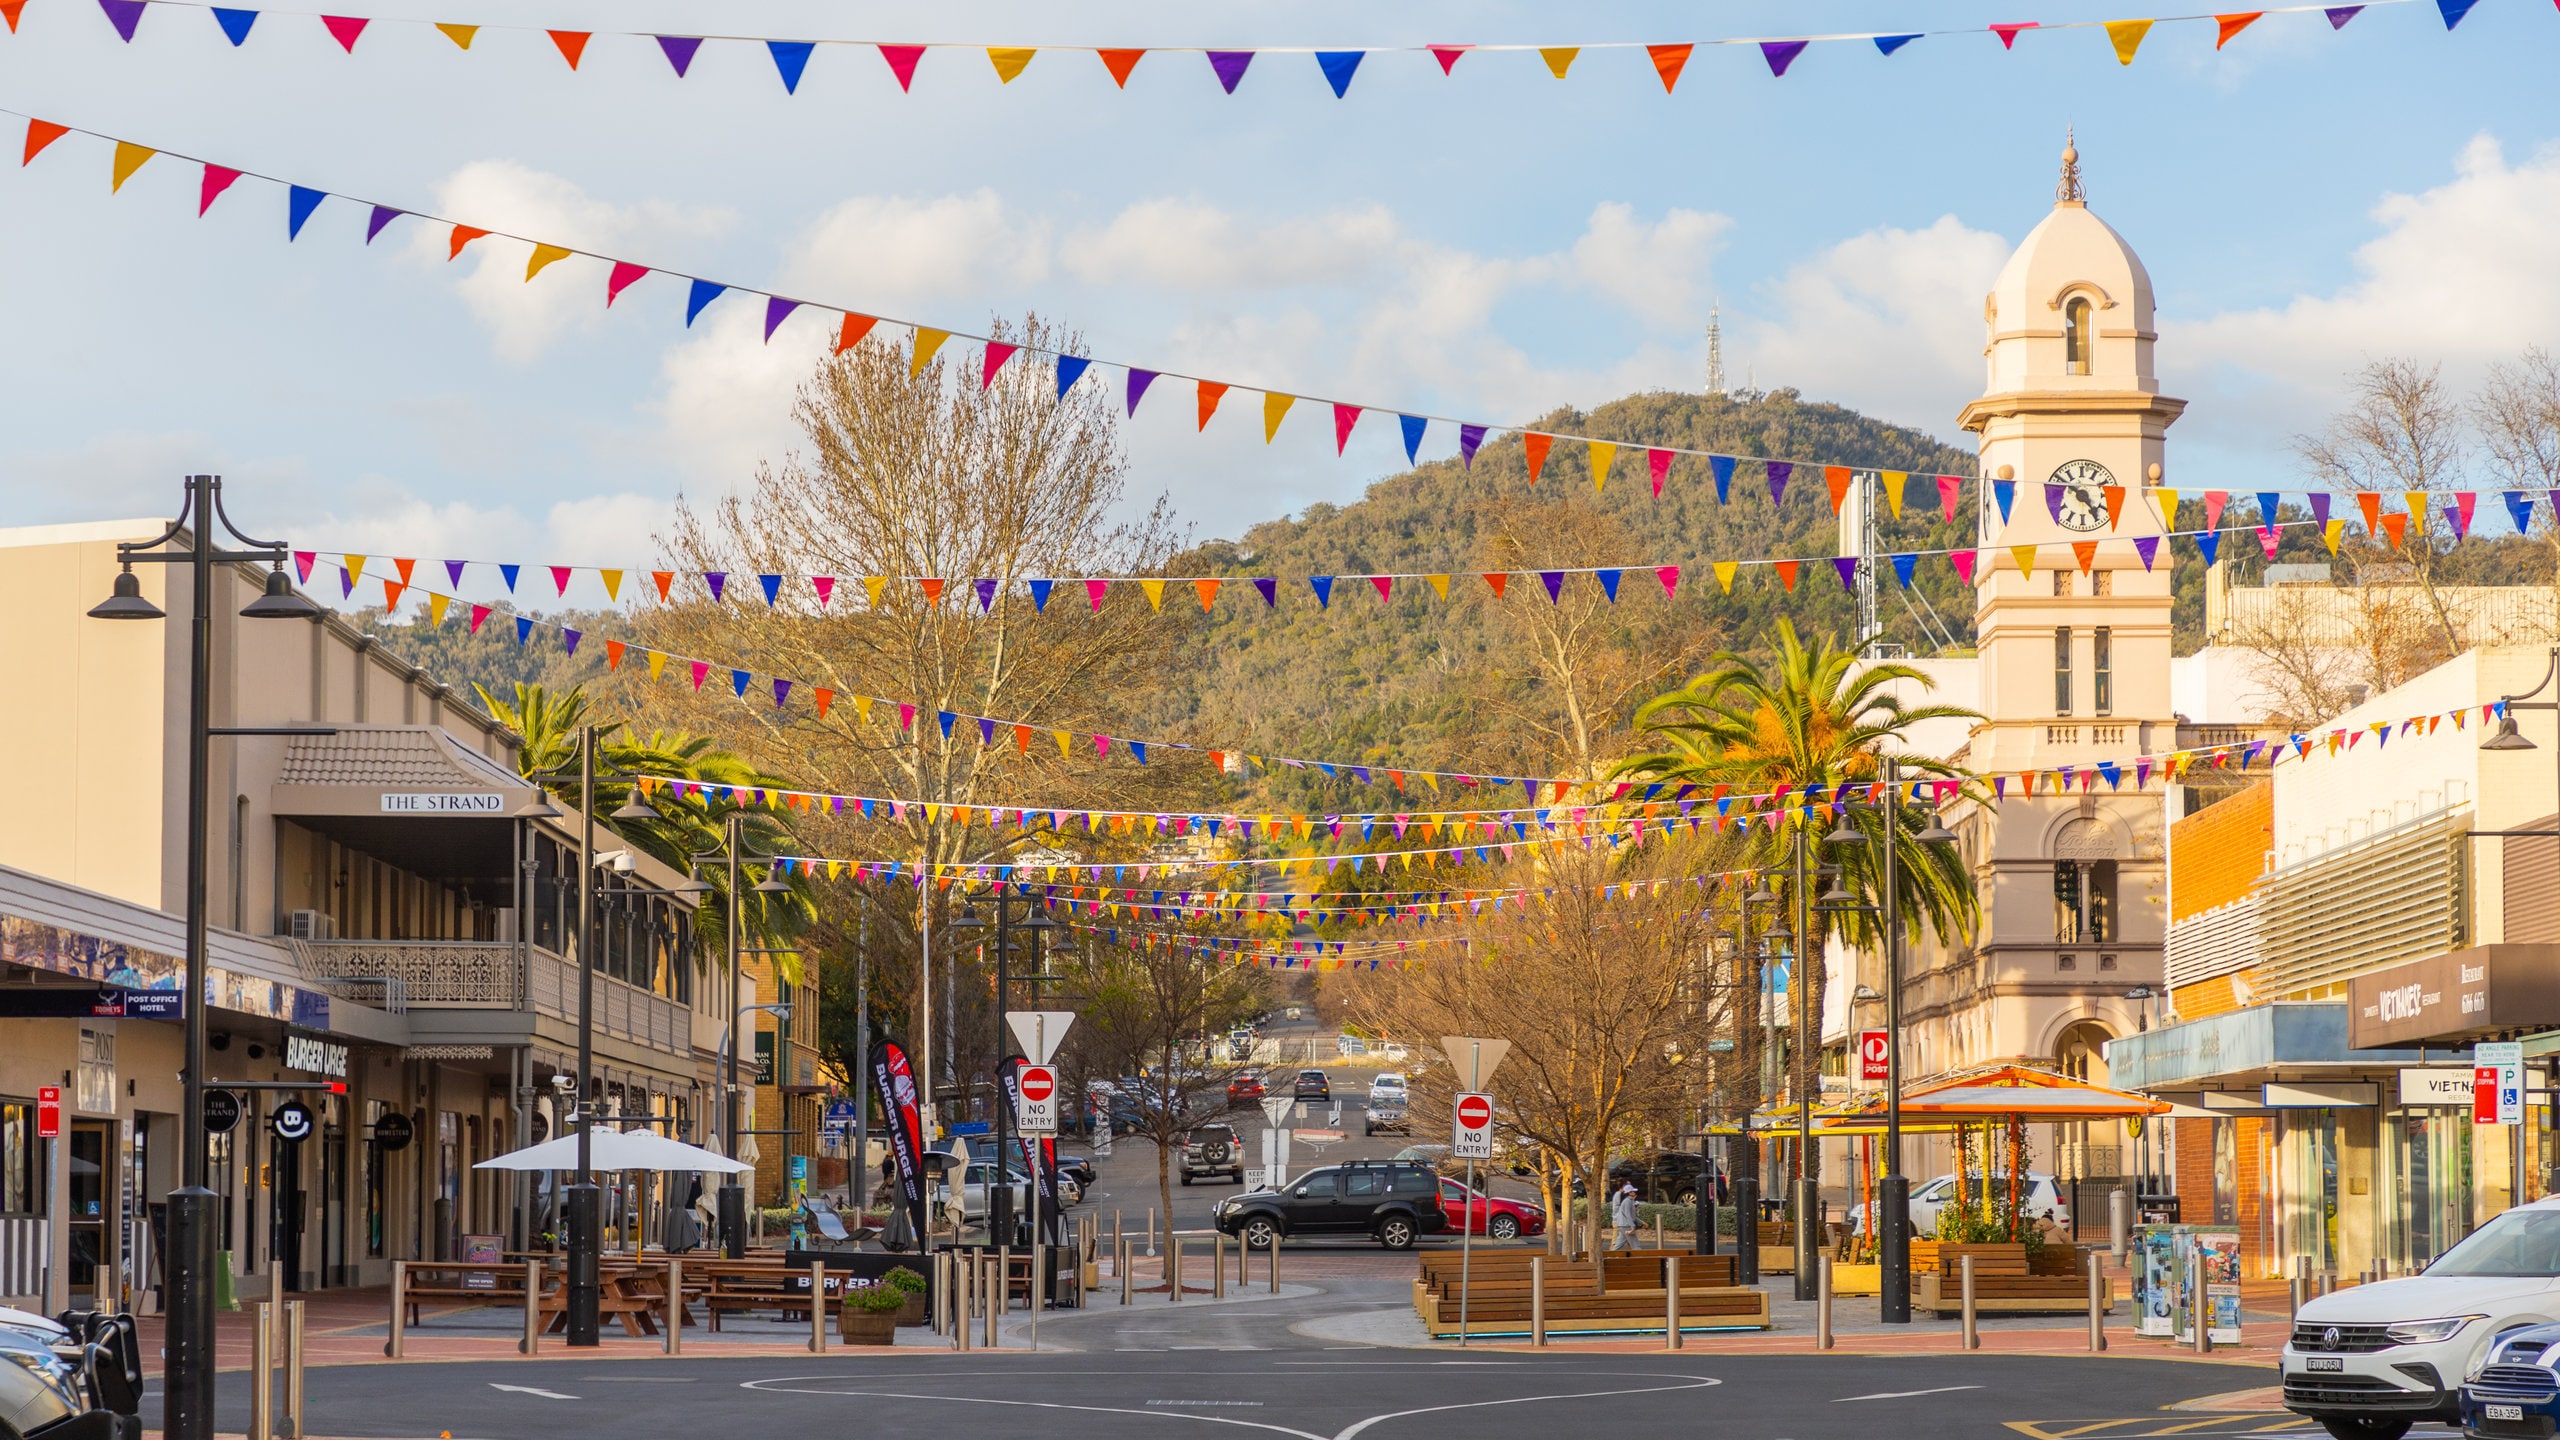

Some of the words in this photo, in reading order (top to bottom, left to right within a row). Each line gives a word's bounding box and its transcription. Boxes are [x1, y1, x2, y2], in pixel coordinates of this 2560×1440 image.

[385, 796, 419, 809] THE
[427, 796, 500, 809] STRAND
[2380, 983, 2421, 1022] VIETNAMESE
[95, 1032, 114, 1061] POST
[287, 1035, 324, 1073] BURGER
[324, 1043, 348, 1077] URGE
[2483, 1070, 2490, 1078] NO
[2505, 1070, 2515, 1084] P
[2429, 1080, 2475, 1095] VIETN
[44, 1091, 54, 1099] NO
[203, 1109, 235, 1117] TRAND
[1028, 1105, 1046, 1115] NO
[875, 1063, 899, 1131] BURGER
[894, 1132, 913, 1178] URGE
[1021, 1117, 1053, 1126] ENTRY
[1464, 1132, 1482, 1143] NO
[1456, 1145, 1488, 1154] ENTRY
